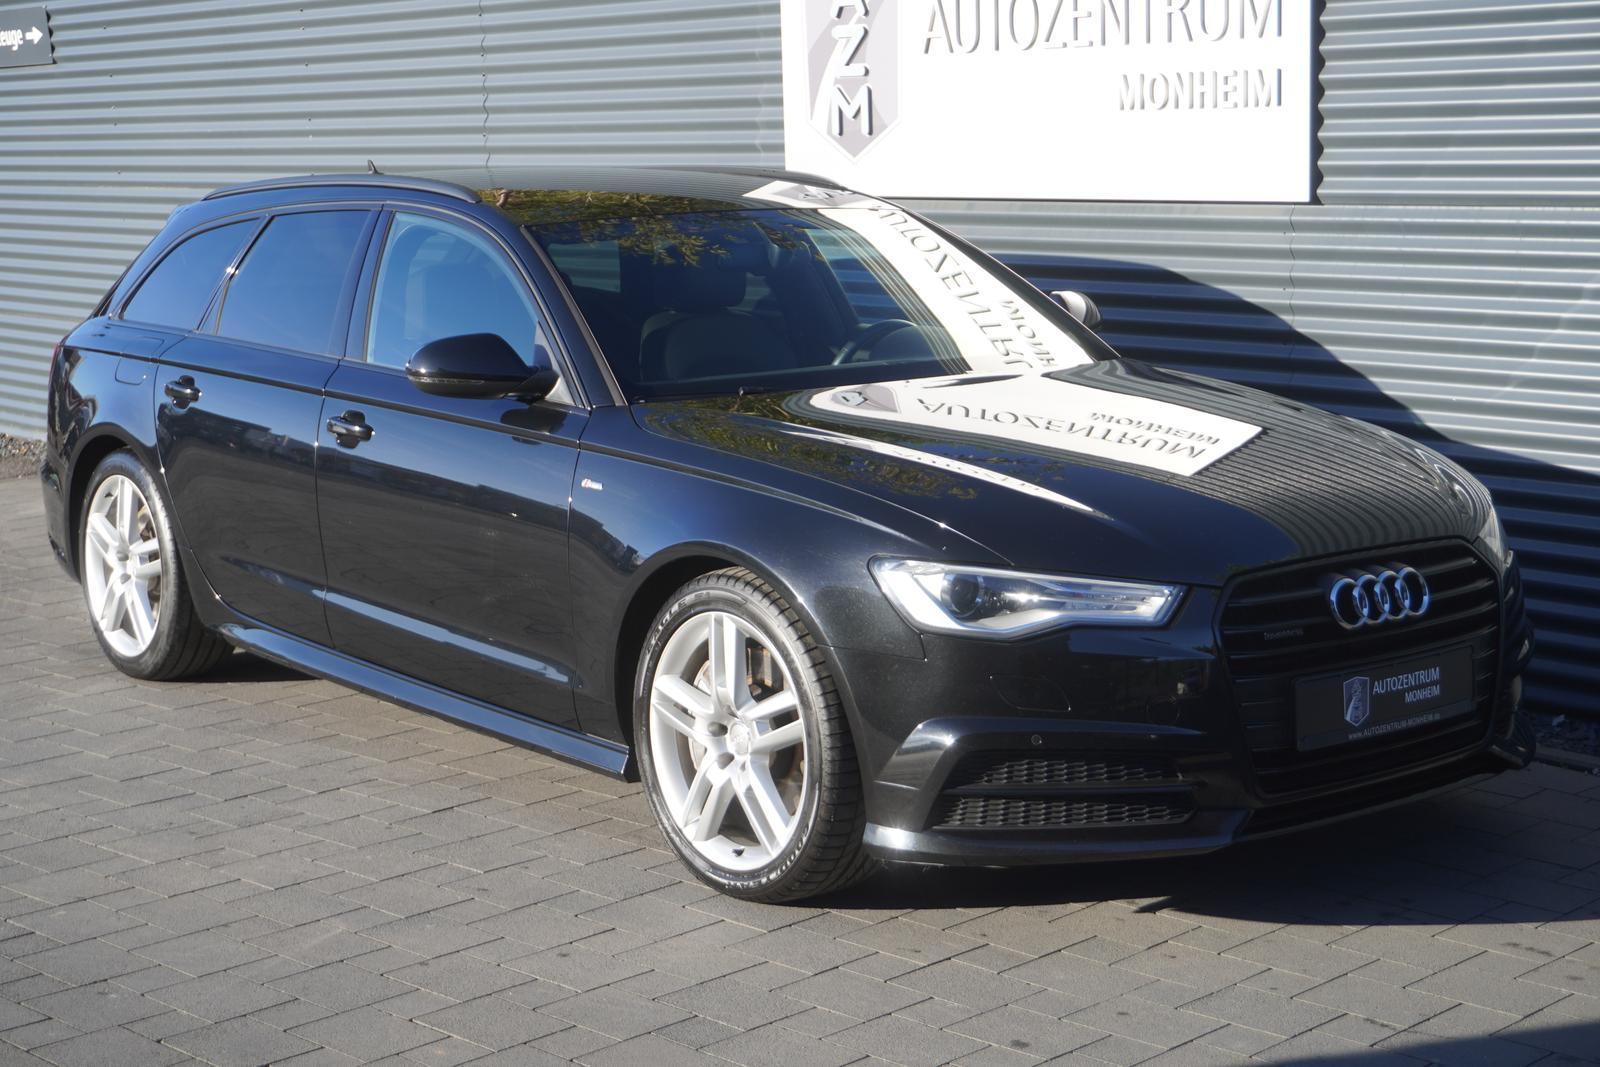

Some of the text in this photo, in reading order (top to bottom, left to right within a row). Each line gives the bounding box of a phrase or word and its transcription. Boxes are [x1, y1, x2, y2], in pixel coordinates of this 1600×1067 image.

[0, 29, 24, 51] euge
[1119, 67, 1283, 111] MONHEIM
[1372, 666, 1440, 695] AUTOZENTRUM
[1404, 684, 1440, 703] MONHEIM
